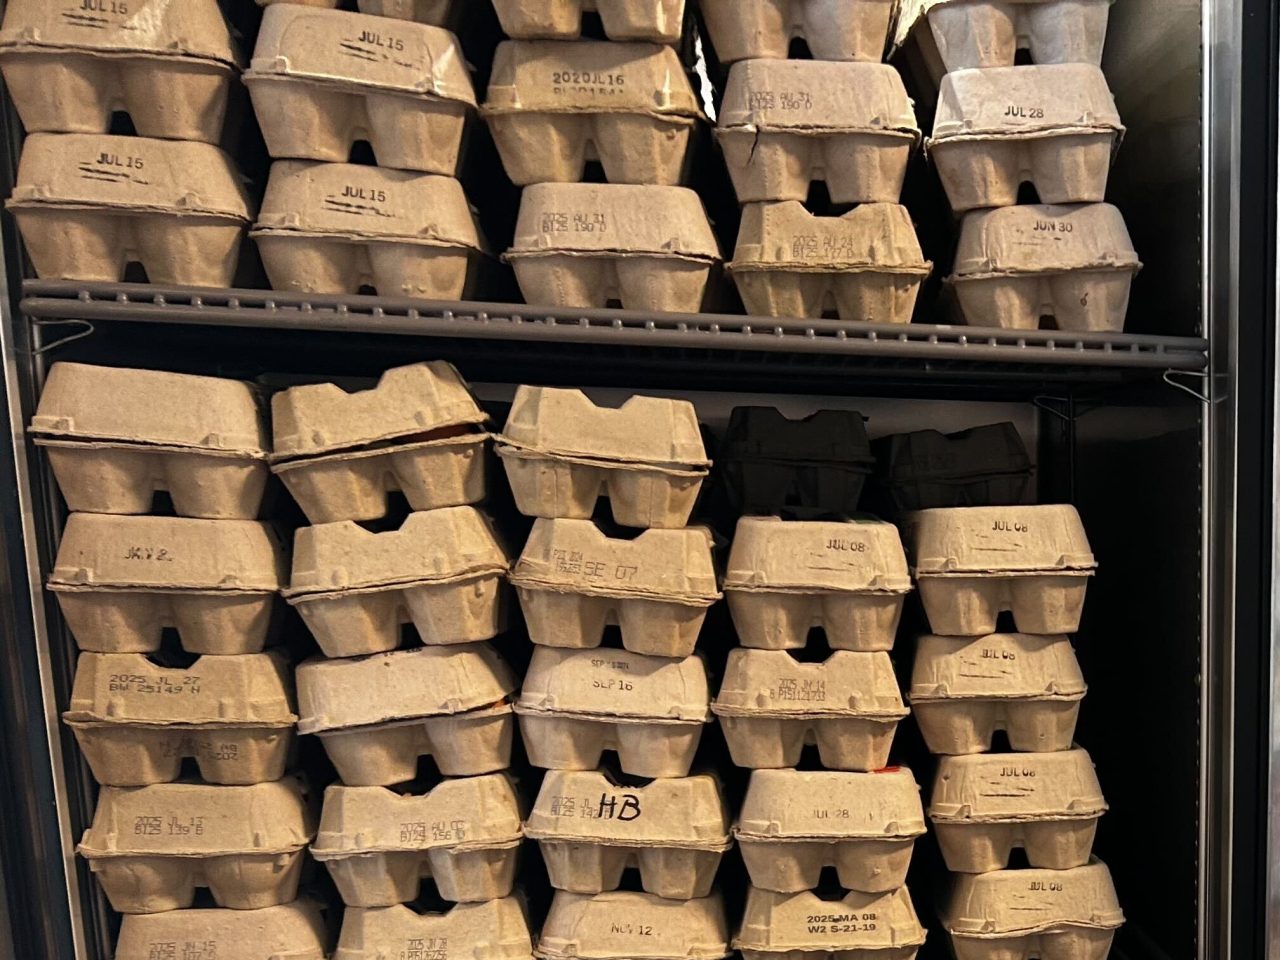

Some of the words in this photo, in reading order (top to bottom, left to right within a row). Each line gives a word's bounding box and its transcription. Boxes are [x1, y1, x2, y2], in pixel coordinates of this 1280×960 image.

[79, 0, 107, 13] JUL
[111, 2, 128, 14] 15
[358, 30, 387, 49] JUL
[388, 37, 404, 51] 15
[1004, 105, 1027, 117] JUL
[1028, 107, 1044, 119] 28
[97, 153, 124, 168] JUL
[126, 157, 144, 169] 15
[342, 186, 368, 200] JUL
[369, 189, 386, 202] 15
[1033, 219, 1056, 231] JUN
[1058, 221, 1073, 232] 30
[992, 520, 1013, 532] JUL
[1014, 522, 1028, 533] 08
[826, 538, 848, 551] JUL
[849, 541, 866, 553] 08
[1002, 650, 1016, 661] 08
[109, 674, 146, 684] 2025
[619, 679, 633, 691] 16
[999, 766, 1020, 777] JUL
[1022, 768, 1036, 778] 08
[598, 792, 642, 821] HB
[834, 809, 850, 820] 28
[1028, 881, 1047, 891] JUL
[1049, 882, 1063, 892] 08
[862, 912, 877, 922] 08
[638, 924, 653, 936] 12
[807, 925, 827, 934] W2
[830, 923, 877, 933] S-21-19
